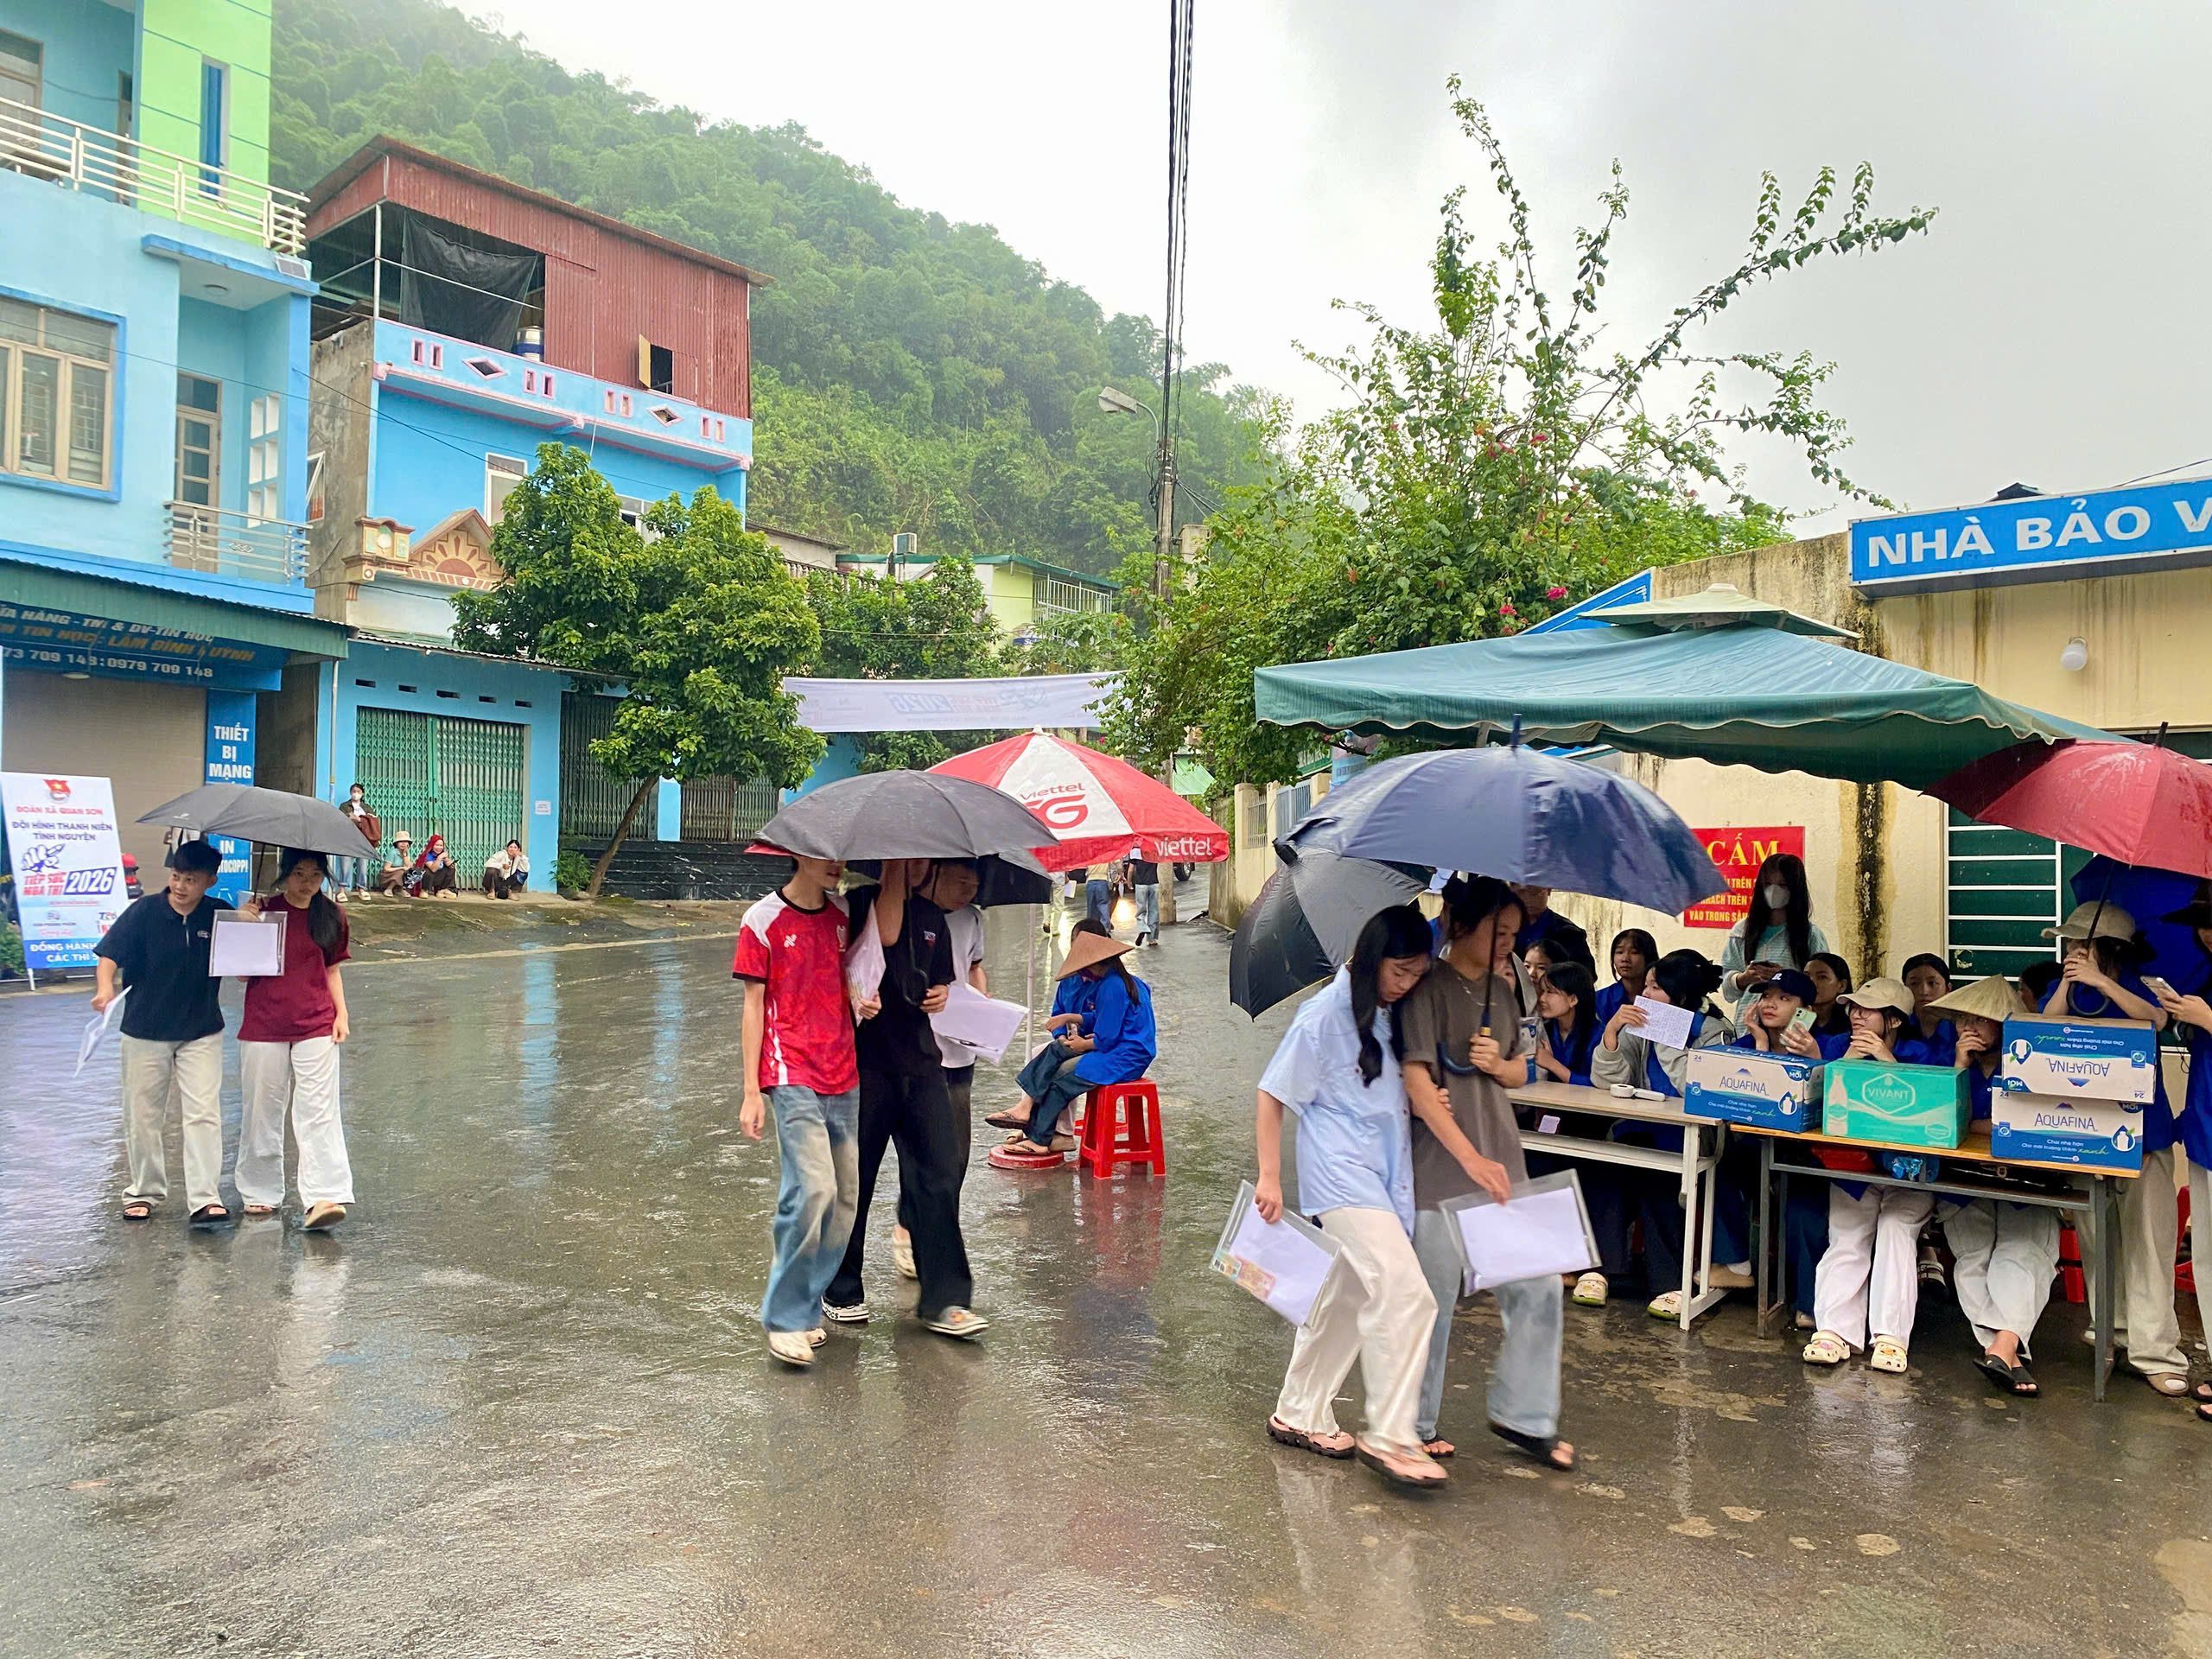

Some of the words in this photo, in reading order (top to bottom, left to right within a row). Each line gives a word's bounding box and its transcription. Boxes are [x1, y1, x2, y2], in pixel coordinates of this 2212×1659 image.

[1868, 517, 1995, 568] NHÀ
[2016, 499, 2151, 551] BẢO
[21, 609, 71, 625] HÀNG
[111, 621, 124, 632] &
[29, 650, 60, 663] 709
[152, 662, 180, 674] 709
[186, 666, 213, 677] 148
[214, 722, 249, 741] THIẾT
[221, 746, 237, 762] BỊ
[209, 763, 251, 780] MẠNG
[1020, 783, 1085, 800] viettel
[219, 840, 234, 854] IN
[1154, 836, 1212, 856] viettel
[1707, 832, 1780, 866] CẤM
[66, 868, 115, 893] 2026
[1732, 876, 1752, 889] TRÊN
[1727, 893, 1747, 906] TRÊN
[1706, 911, 1730, 922] TRONG
[47, 954, 69, 963] CÁC
[2048, 1060, 2110, 1077] AQUAFINA
[1719, 1076, 1767, 1096] AQUAFINA
[1867, 1087, 1910, 1100] VIVANT
[2034, 1113, 2095, 1132] AQUAFINA
